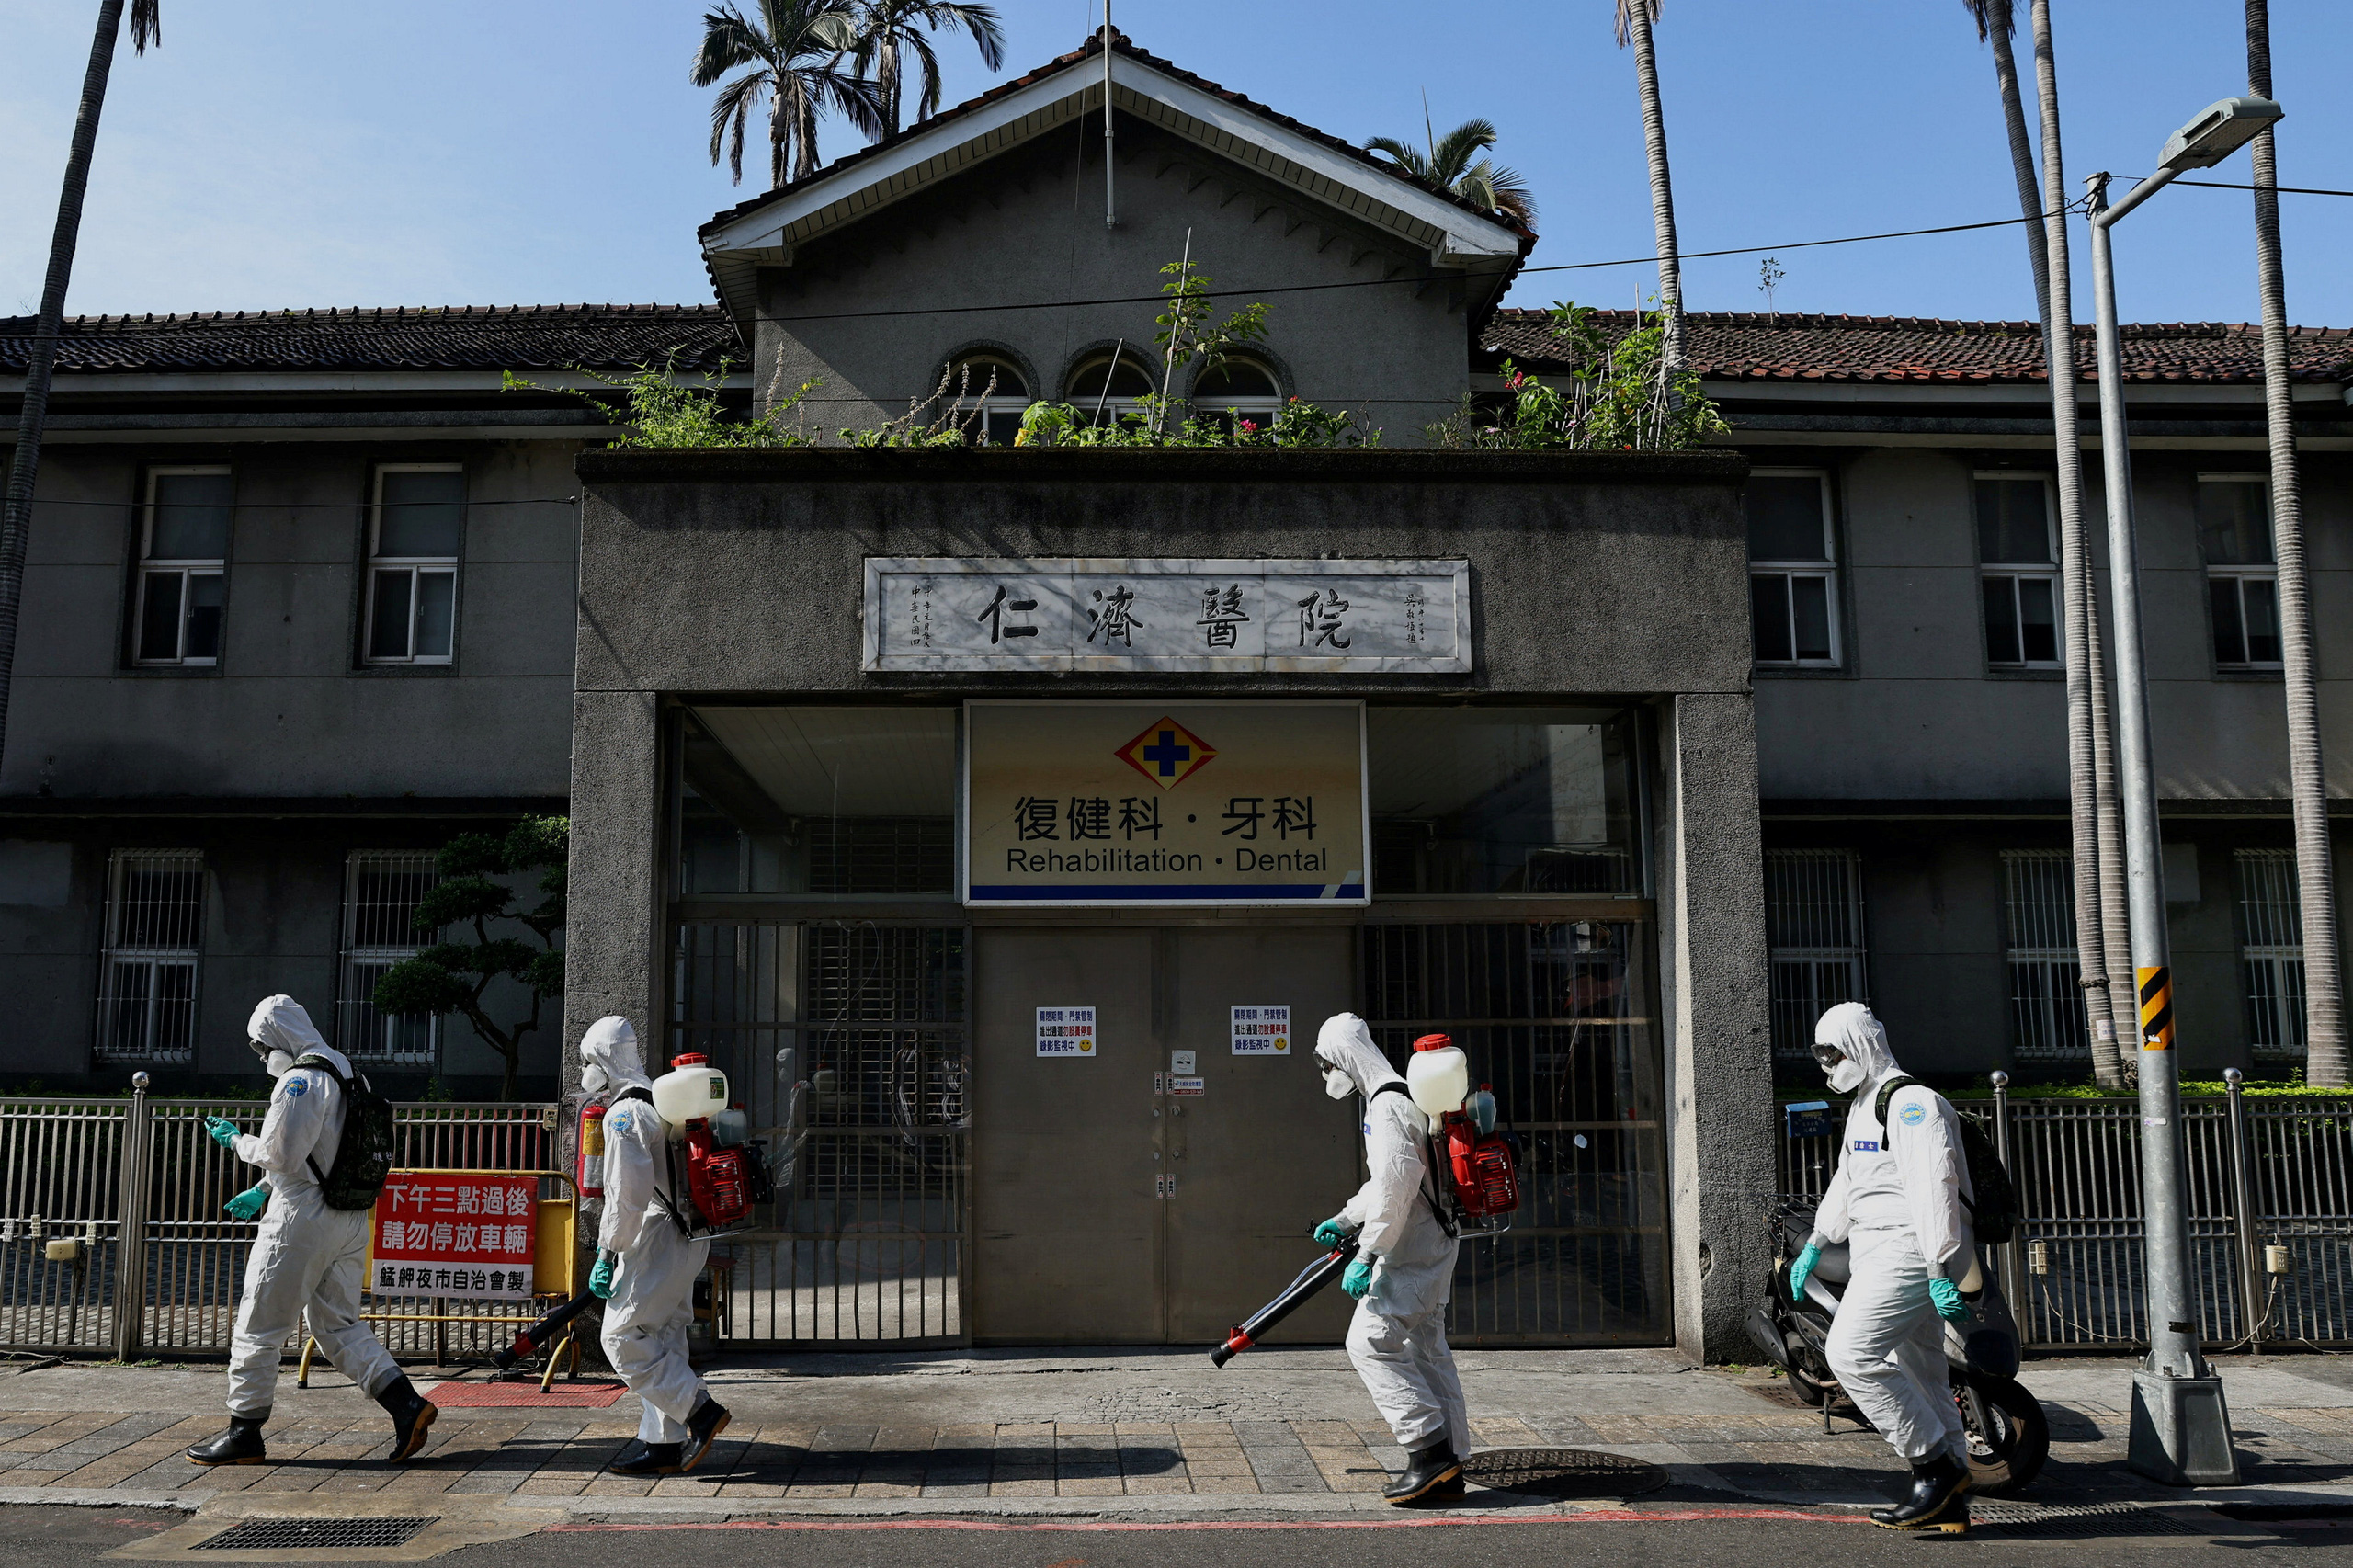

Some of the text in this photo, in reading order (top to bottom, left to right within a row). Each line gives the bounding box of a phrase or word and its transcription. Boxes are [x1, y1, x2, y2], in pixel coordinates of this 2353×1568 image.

[977, 583, 1352, 651] 仁濟醫院
[1007, 847, 1327, 873] Rehabilitation Dental
[384, 1183, 529, 1217] 下午三點過後
[381, 1220, 528, 1255] 請勿停放車輛
[379, 1266, 525, 1292] 艋舺夜市自治會製
